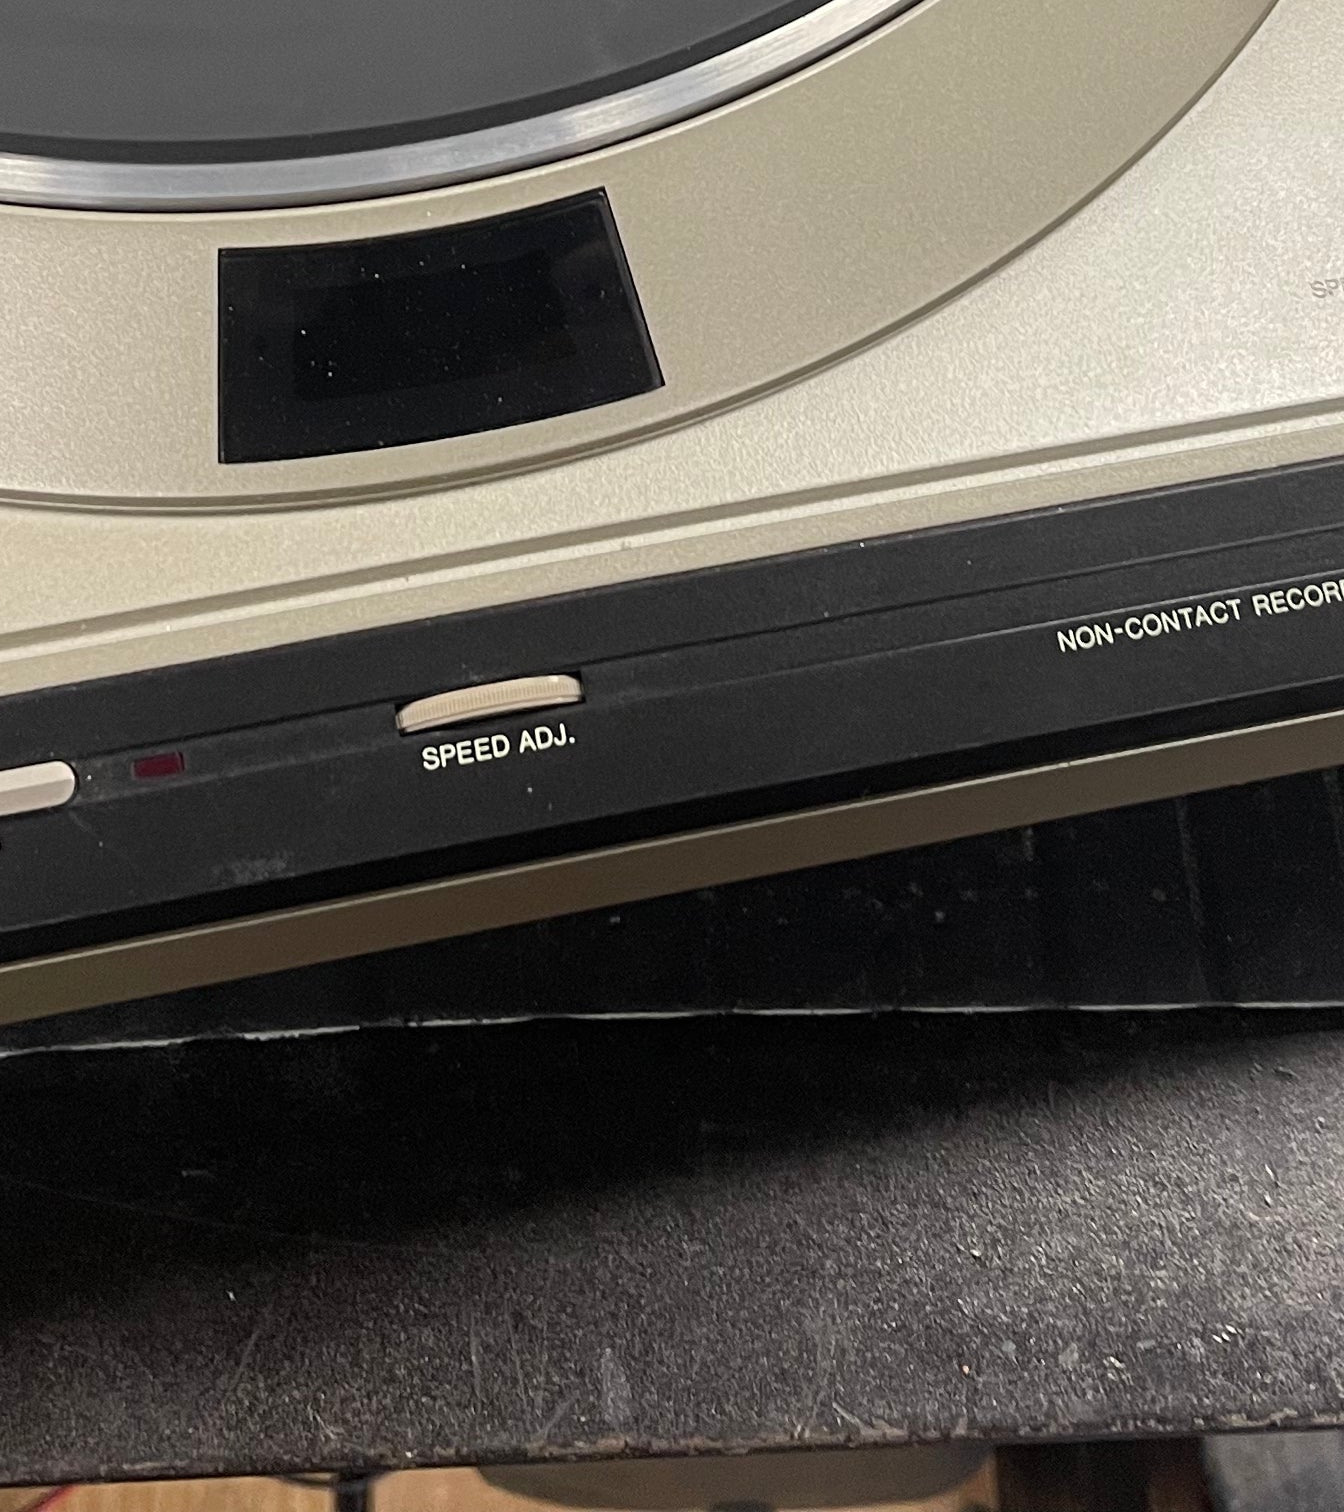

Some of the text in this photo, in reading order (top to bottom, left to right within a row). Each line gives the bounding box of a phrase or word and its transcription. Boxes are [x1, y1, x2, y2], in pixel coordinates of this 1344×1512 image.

[1056, 597, 1241, 653] NON-CONTACT
[421, 722, 576, 771] SPEED ADJ.
